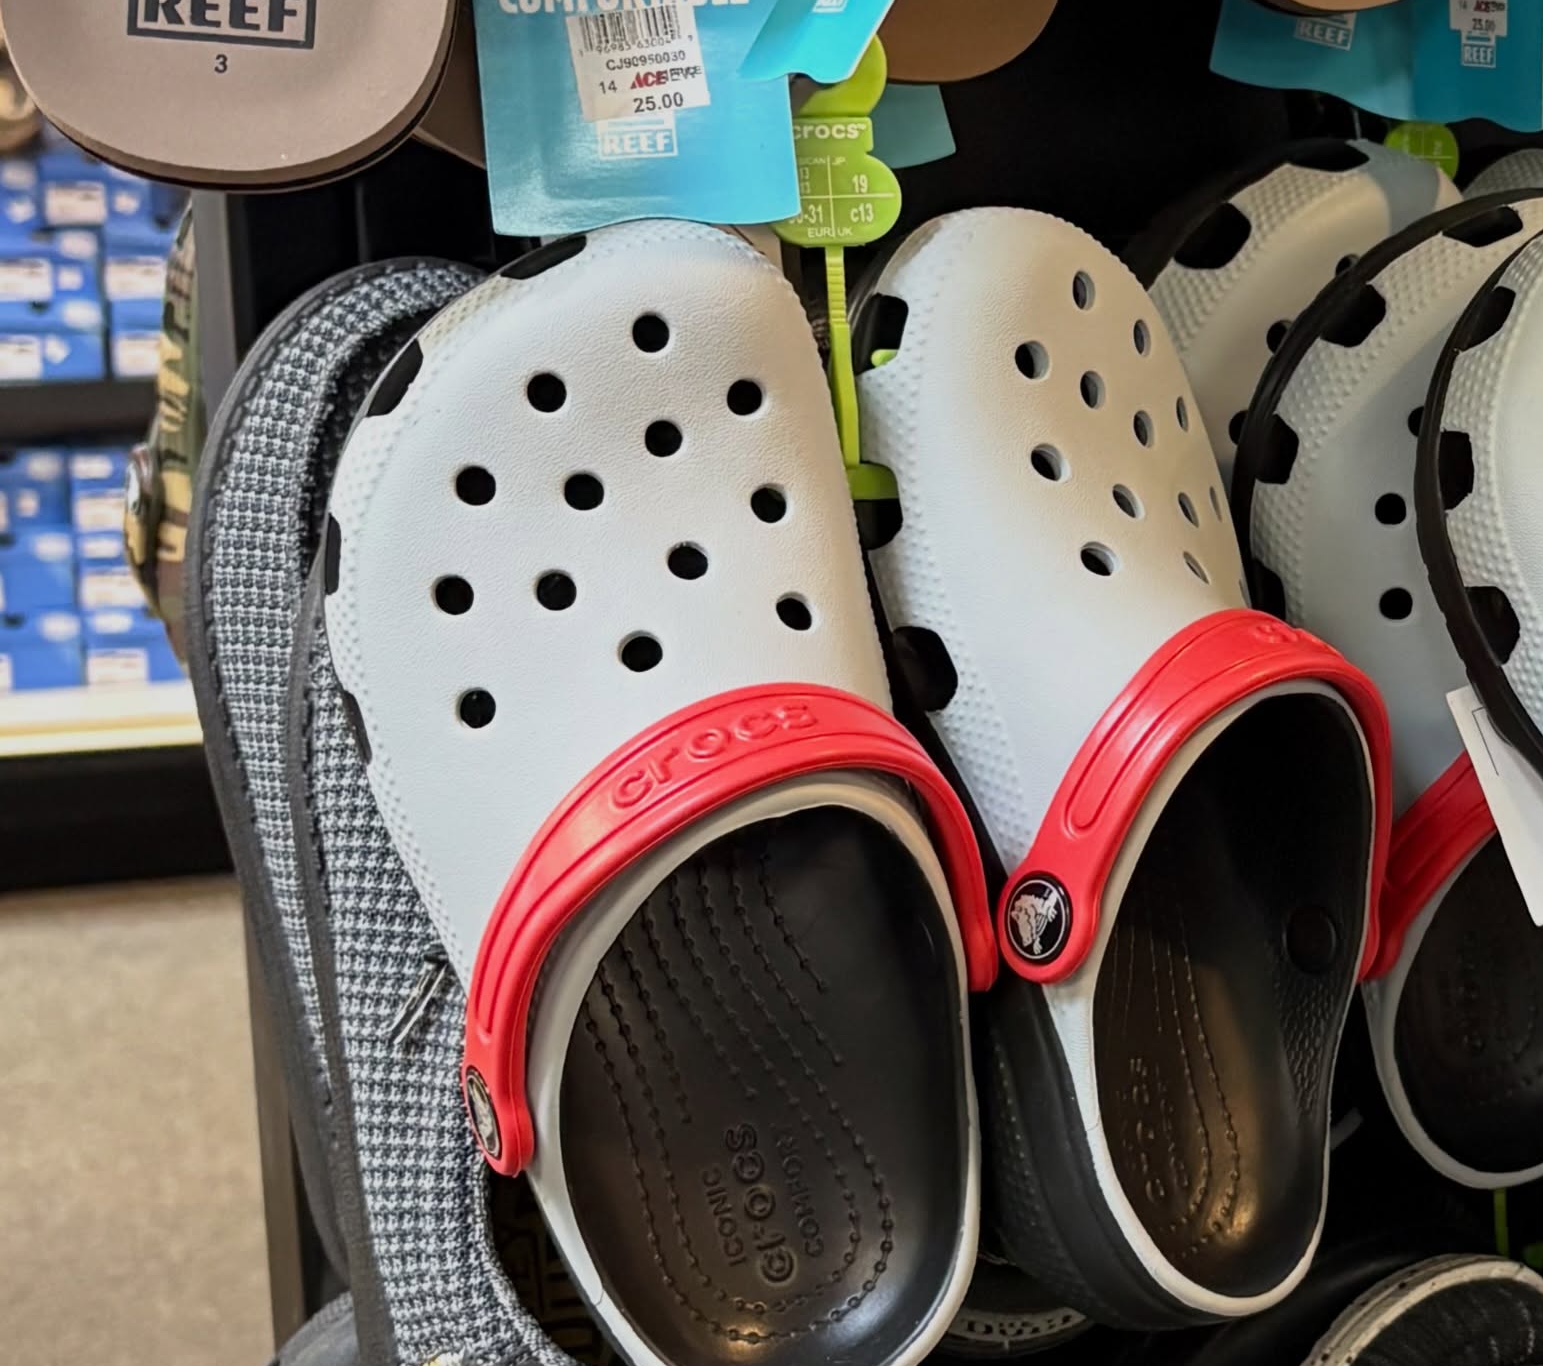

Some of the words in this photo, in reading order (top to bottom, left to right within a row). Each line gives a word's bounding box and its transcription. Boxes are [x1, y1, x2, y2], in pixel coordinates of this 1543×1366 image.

[1299, 22, 1349, 45] REEF
[213, 53, 229, 74] 3
[605, 49, 687, 72] CJ90950030
[1462, 45, 1495, 64] REEF
[598, 81, 618, 95] 14
[629, 69, 668, 91] ACE
[632, 91, 685, 114] 25.00
[600, 129, 673, 156] REEF
[851, 173, 869, 194] 19
[849, 202, 875, 223] c13
[607, 704, 820, 811] crocs
[725, 1122, 796, 1284] crocs
[774, 1125, 826, 1258] COMFOR
[701, 1166, 748, 1267] ICONIC
